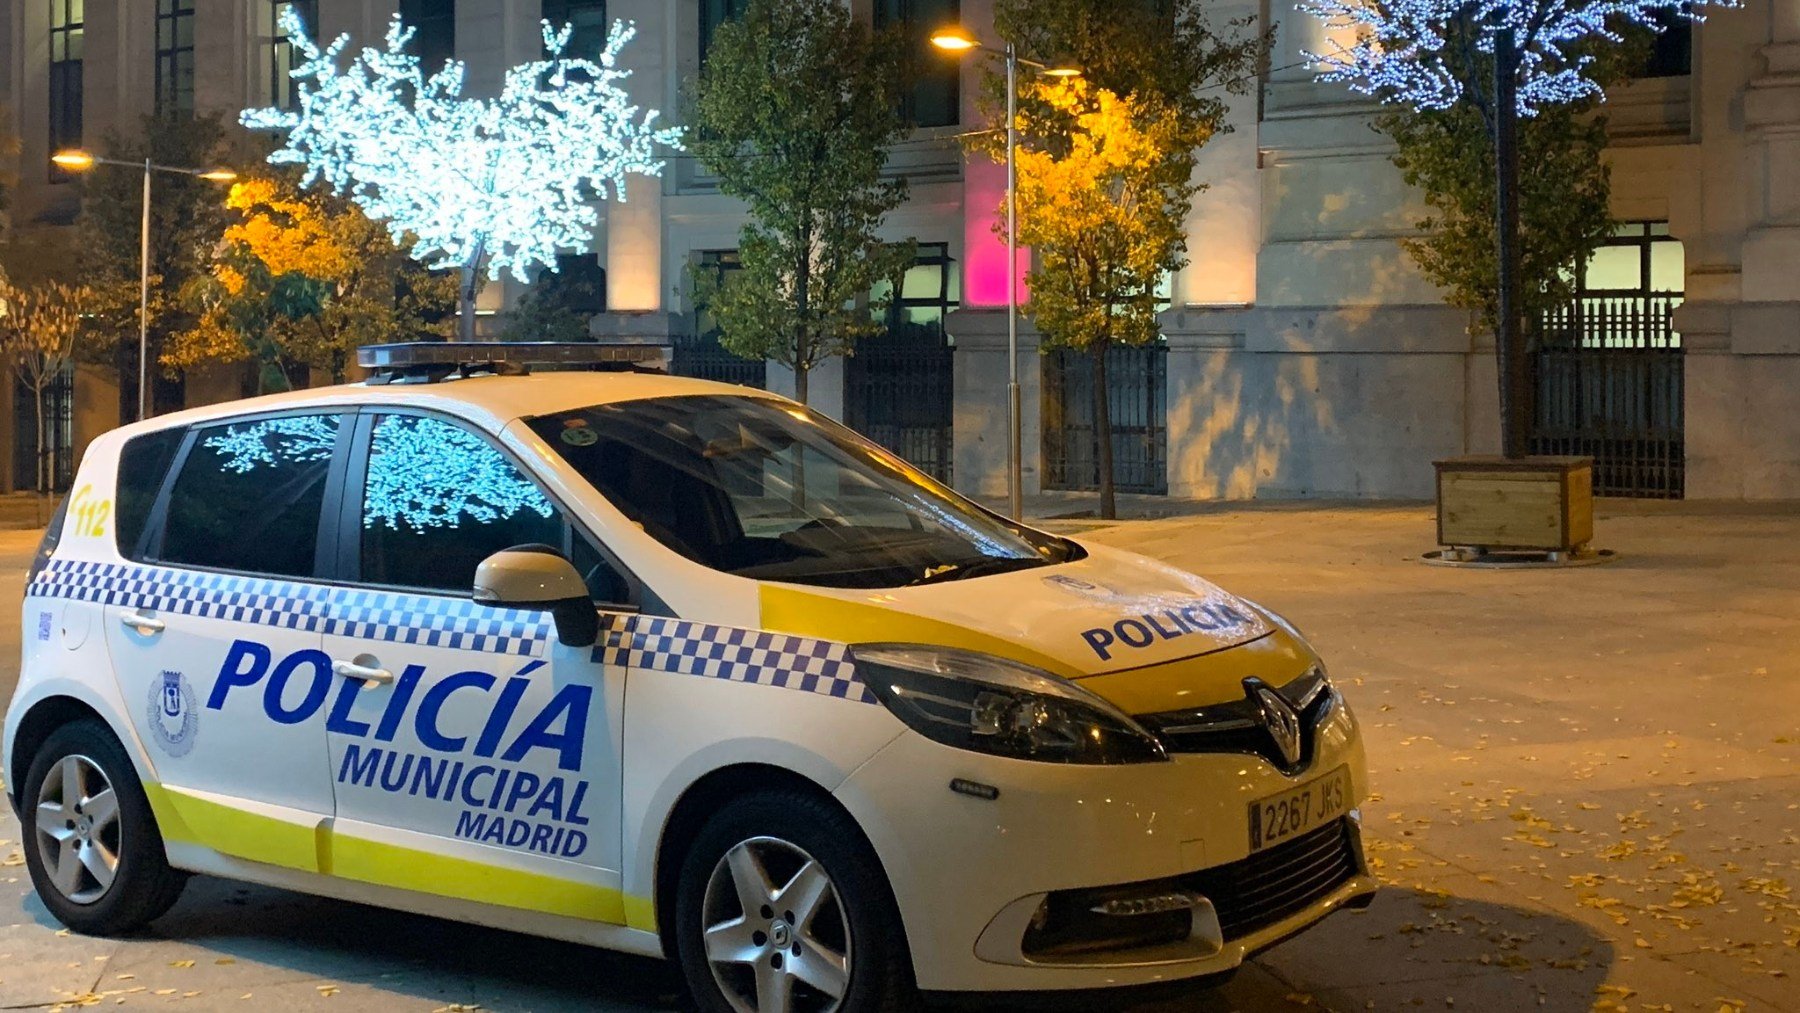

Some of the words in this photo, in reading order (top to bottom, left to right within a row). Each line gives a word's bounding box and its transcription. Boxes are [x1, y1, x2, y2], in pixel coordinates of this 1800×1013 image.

[75, 499, 111, 537] 112
[206, 639, 593, 772] POLICÍA
[338, 744, 590, 825] MUNICIPAL
[1265, 791, 1311, 840] 2267
[1317, 776, 1343, 819] JKS
[454, 811, 588, 858] MADRID
